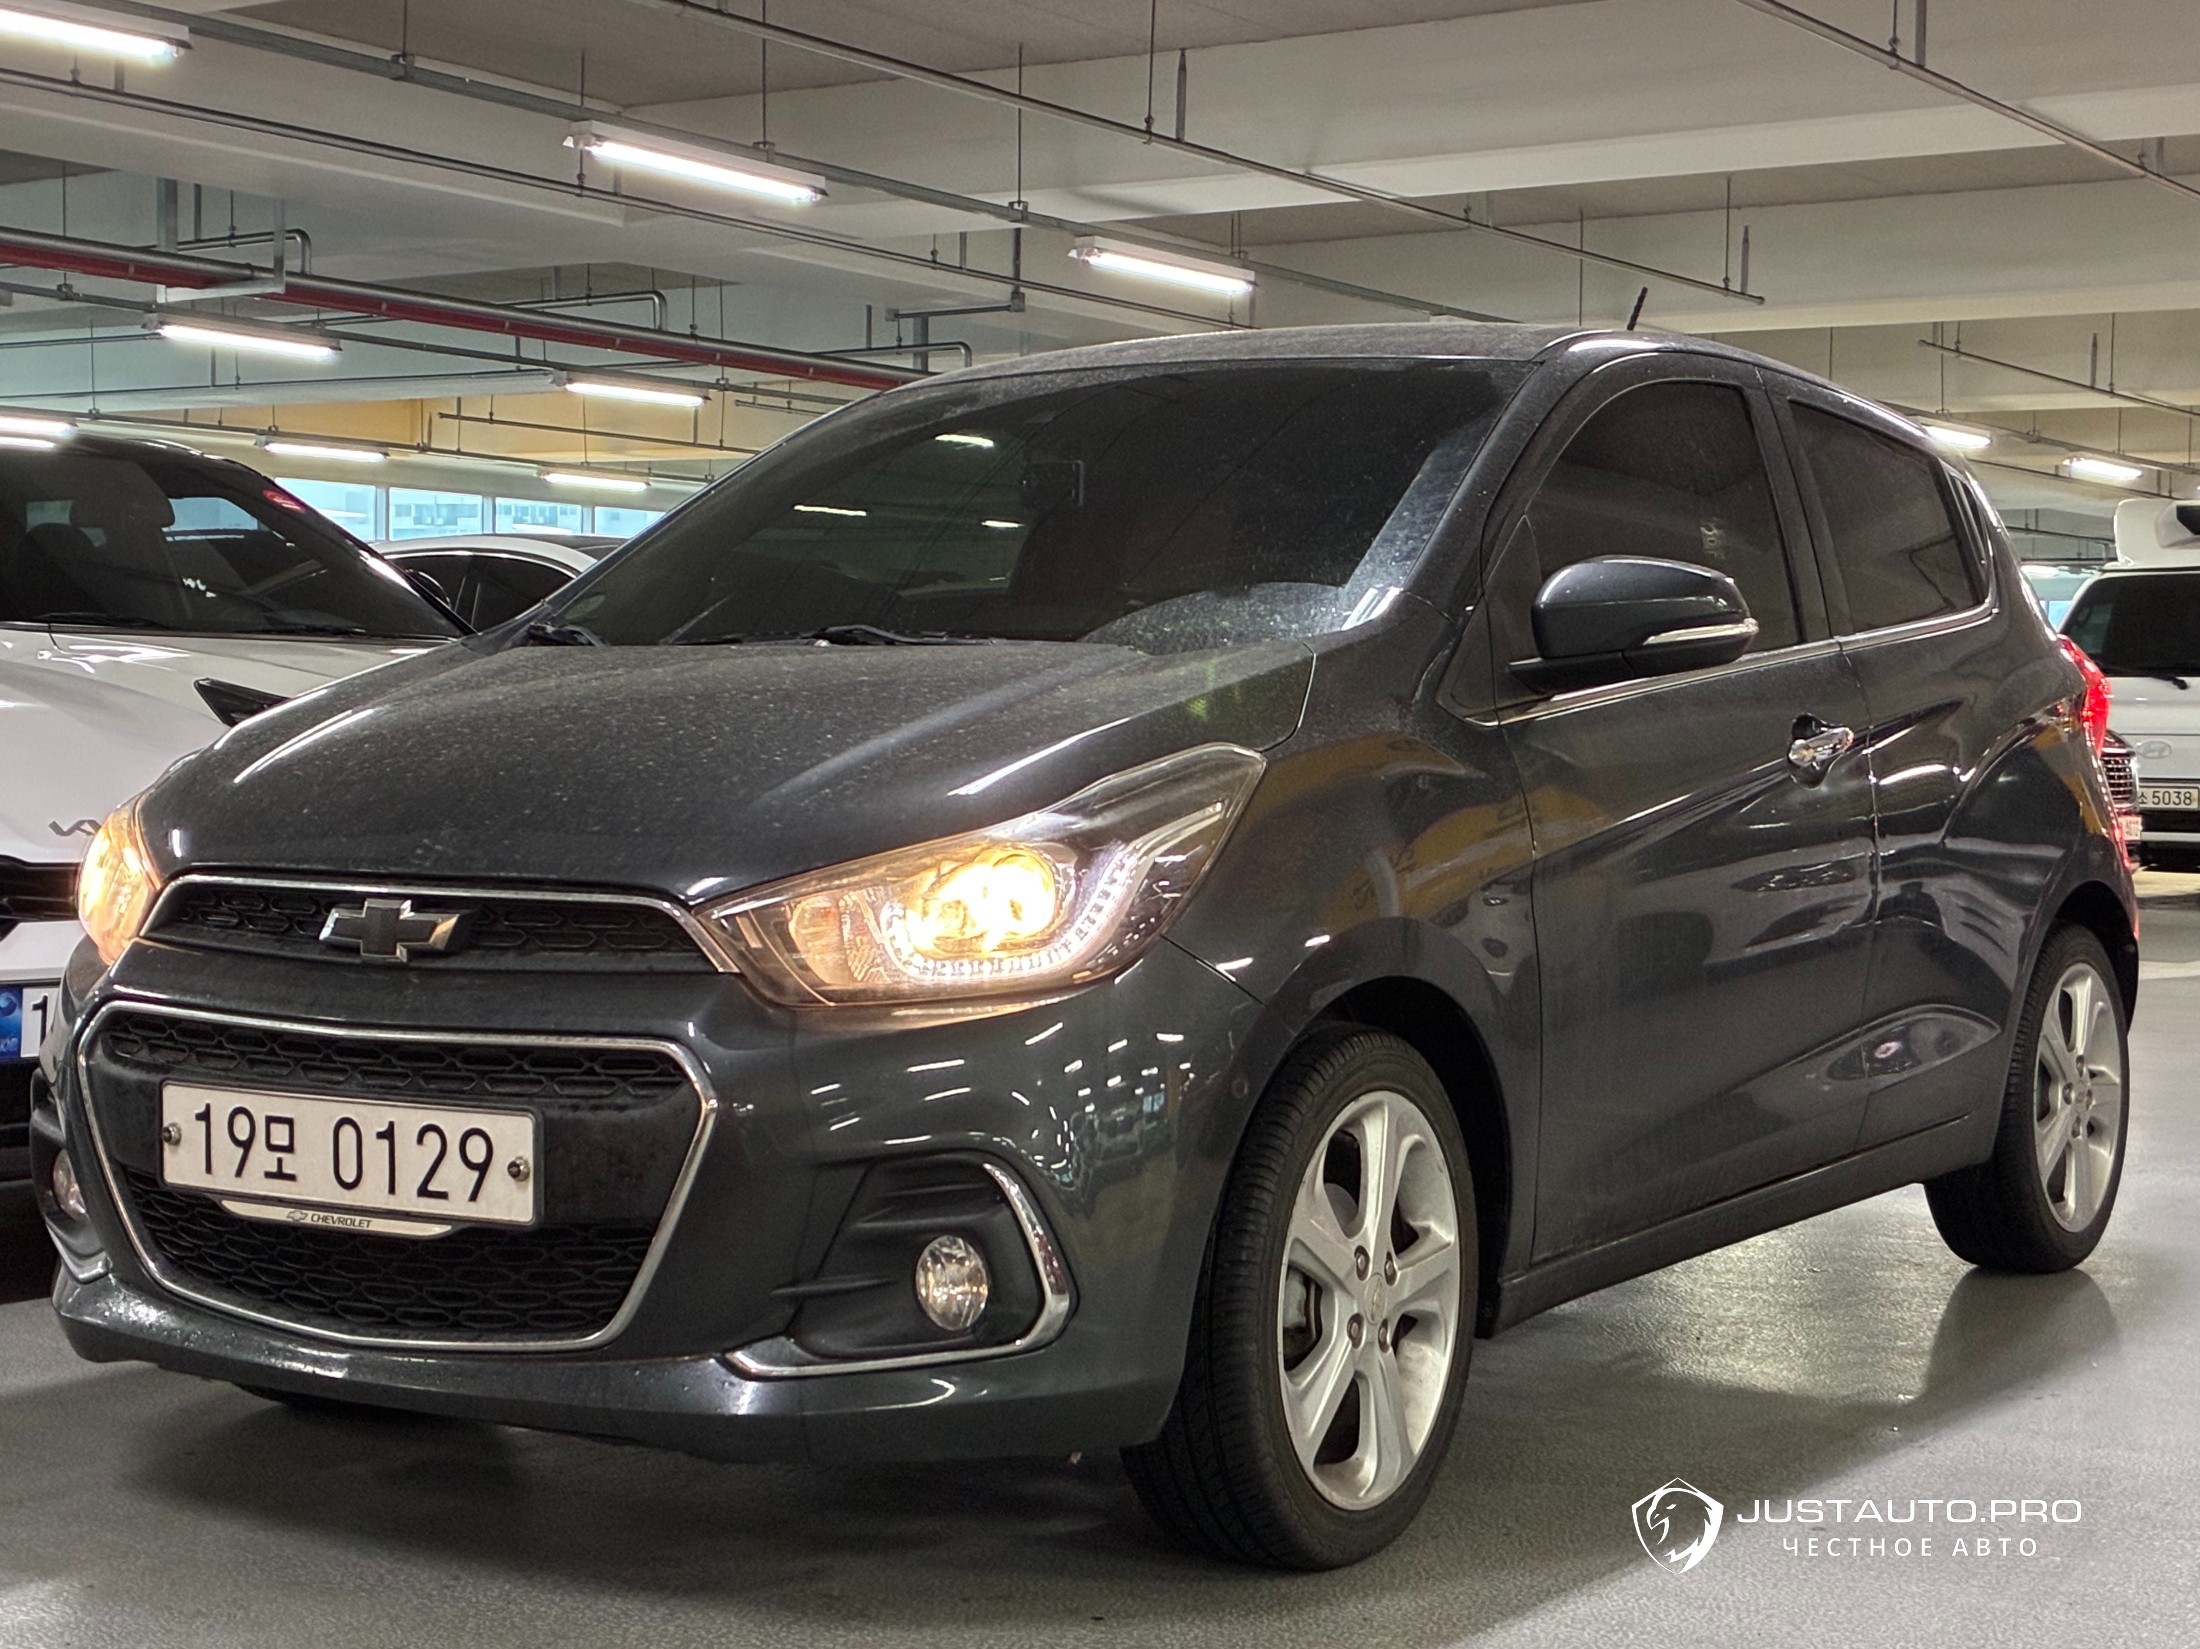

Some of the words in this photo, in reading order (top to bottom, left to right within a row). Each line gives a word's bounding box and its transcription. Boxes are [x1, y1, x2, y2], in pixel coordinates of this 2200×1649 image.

[2152, 790, 2192, 806] 5038
[195, 1102, 298, 1182] 19모
[332, 1116, 495, 1203] 0129
[310, 1213, 373, 1229] CHEVROLET
